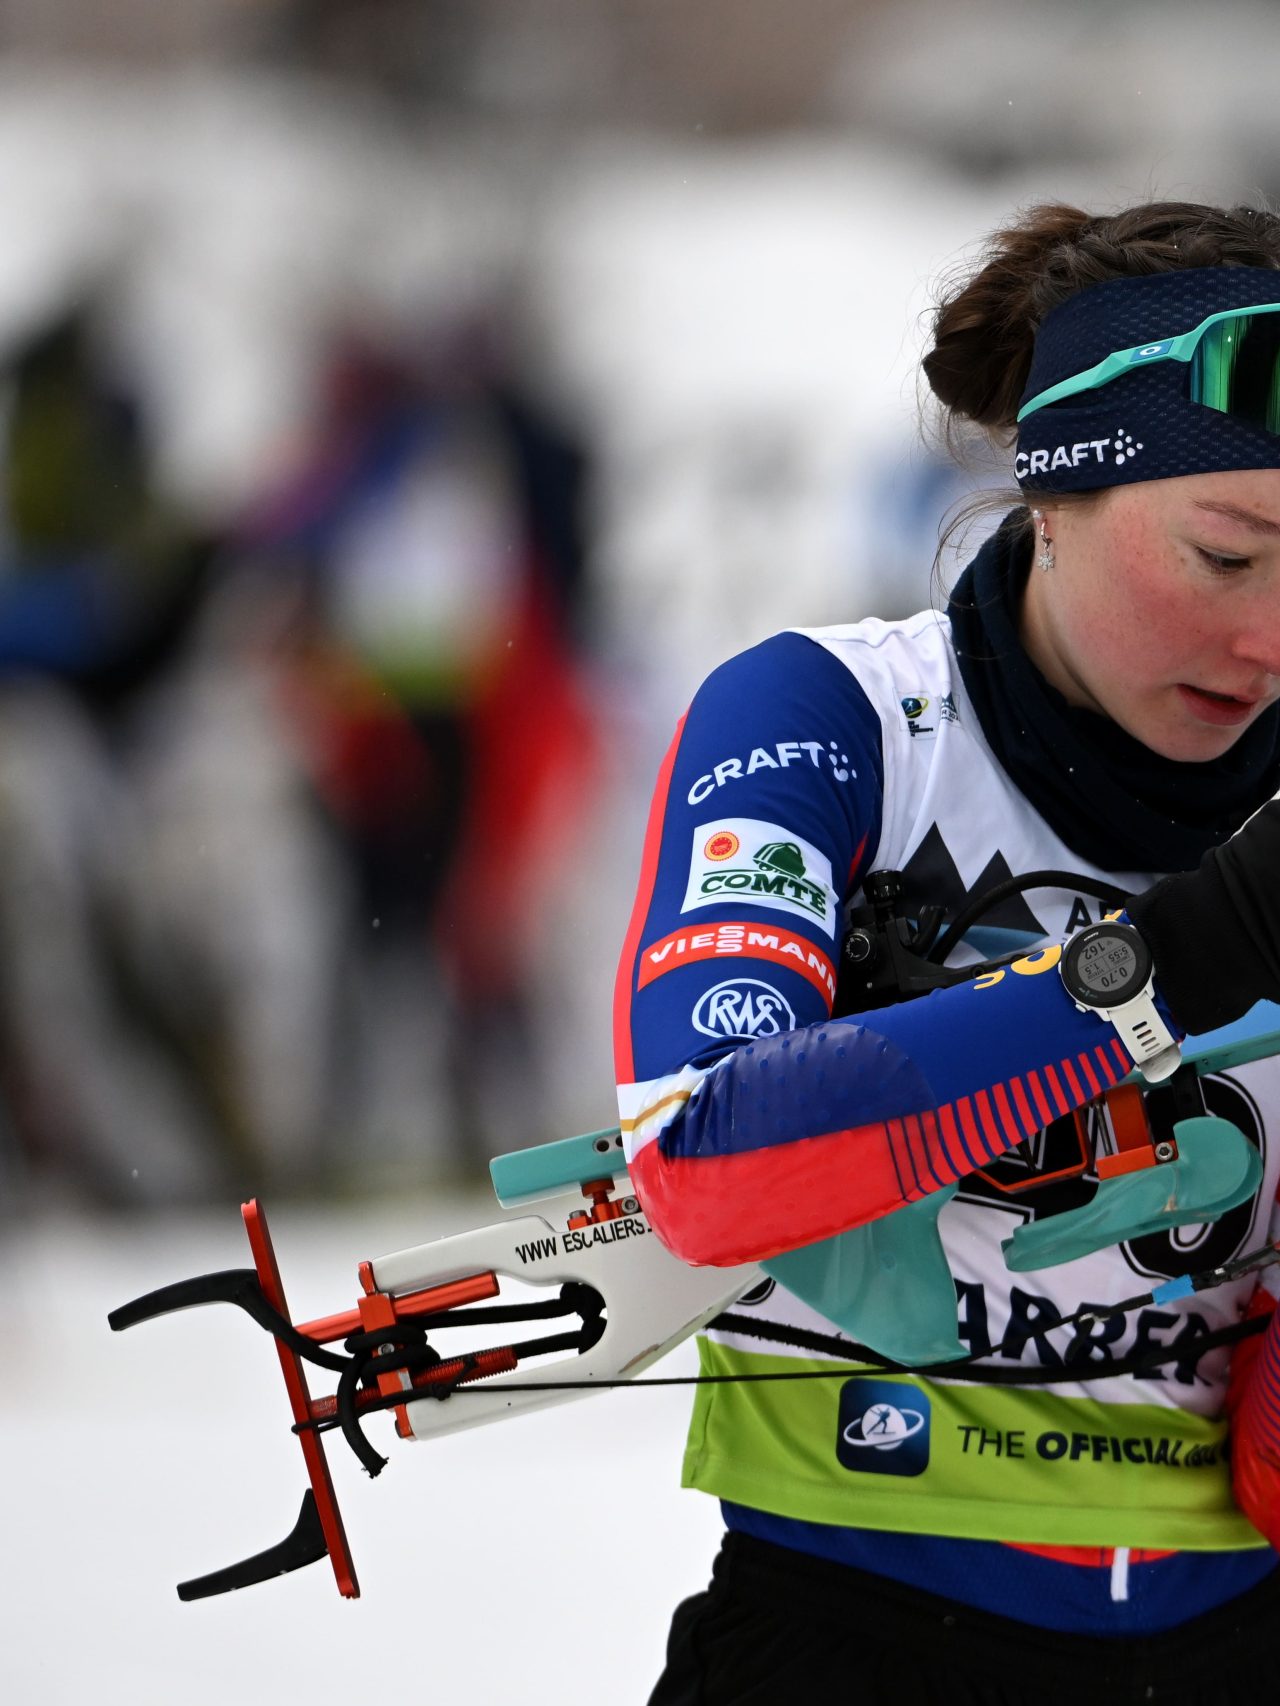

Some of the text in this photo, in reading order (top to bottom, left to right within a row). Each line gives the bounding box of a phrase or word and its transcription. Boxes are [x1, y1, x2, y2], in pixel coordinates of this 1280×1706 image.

[1015, 438, 1110, 479] CRAFT
[688, 741, 826, 806] CRAFT
[649, 925, 836, 1003] VIESSMANN
[707, 989, 783, 1037] RWS
[957, 1425, 1026, 1459] THE
[1035, 1430, 1184, 1468] OFFICIAL
